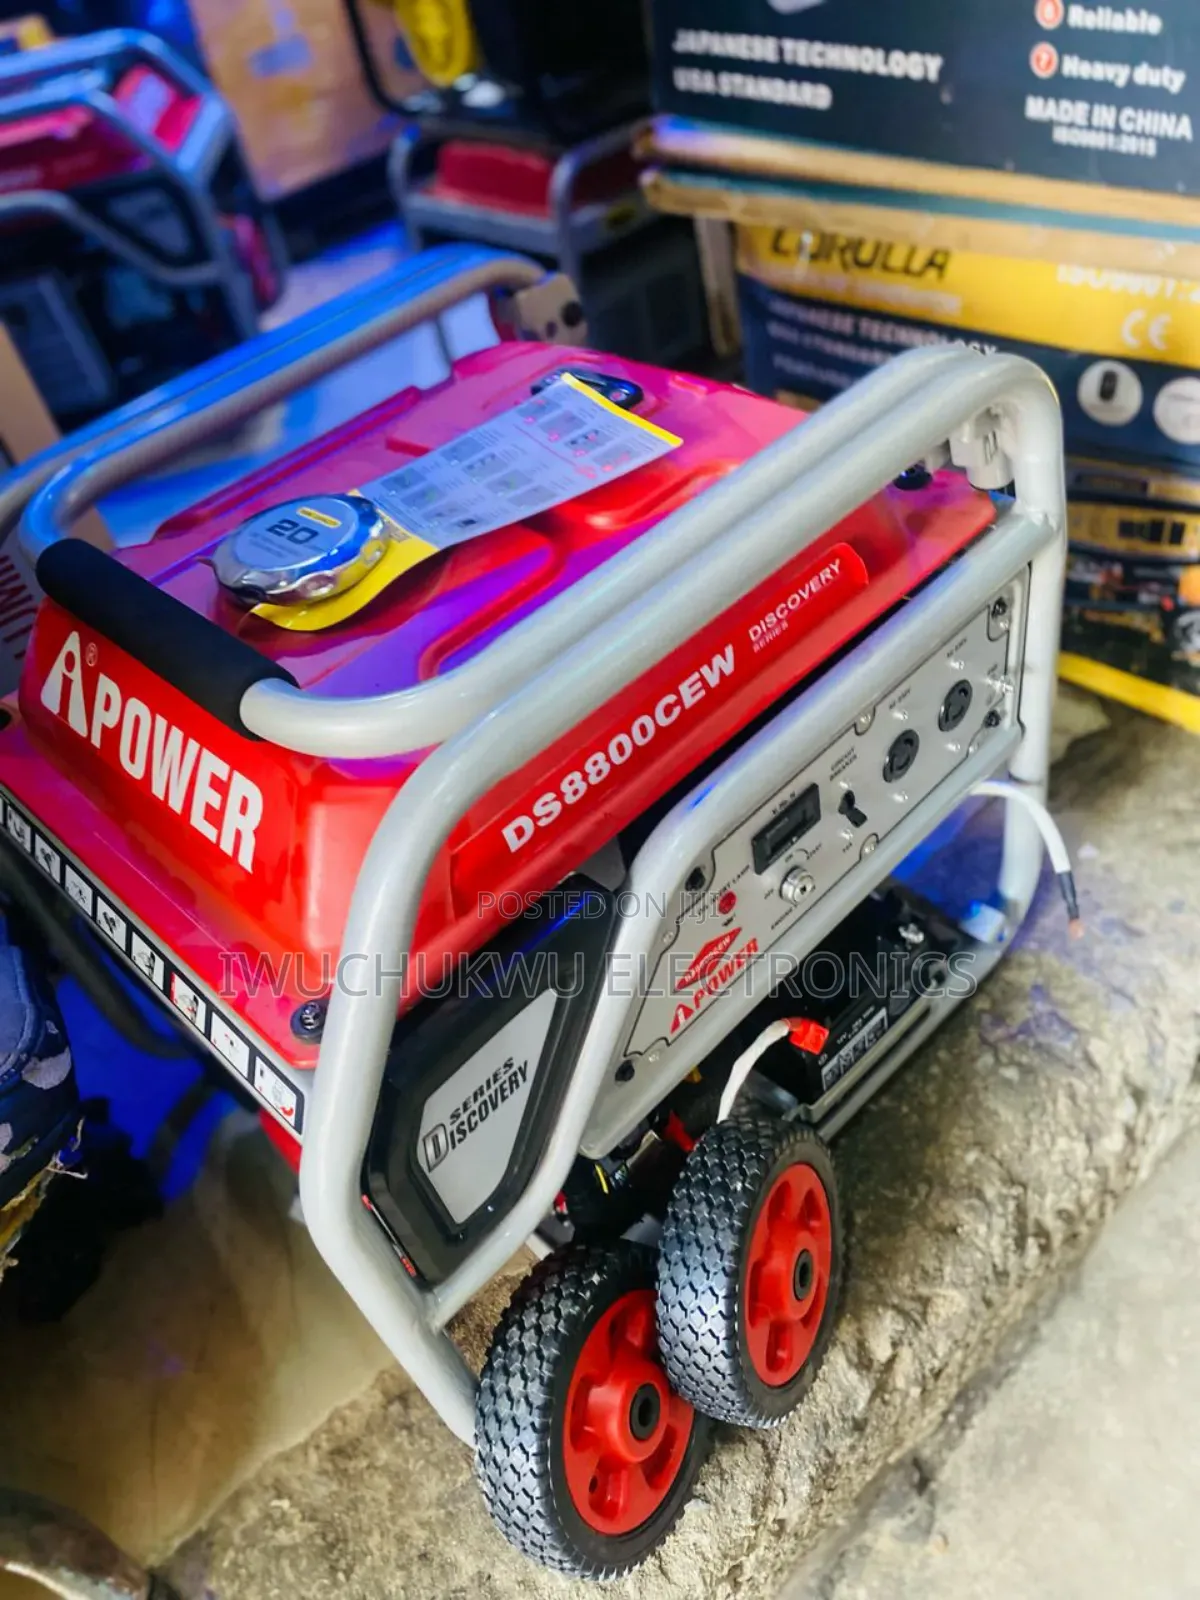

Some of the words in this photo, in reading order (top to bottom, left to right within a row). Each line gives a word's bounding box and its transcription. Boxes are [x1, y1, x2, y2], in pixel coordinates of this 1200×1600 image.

[1067, 4, 1163, 36] Reliable
[673, 28, 780, 64] JAPANESE
[780, 37, 943, 82] TECHNOLOGY
[1061, 54, 1131, 88] Heavy
[1133, 61, 1187, 95] duty
[673, 66, 717, 95] USA
[717, 70, 833, 110] STANDARD
[1025, 94, 1090, 127] MADE
[1091, 103, 1117, 130] IN
[1118, 106, 1193, 142] CHINA
[266, 518, 319, 545] 20
[748, 558, 840, 642] DISCOVERY
[501, 644, 736, 853] DS8800CEW
[449, 1056, 514, 1126] SERIES
[422, 1060, 529, 1174] DISCOVERY
